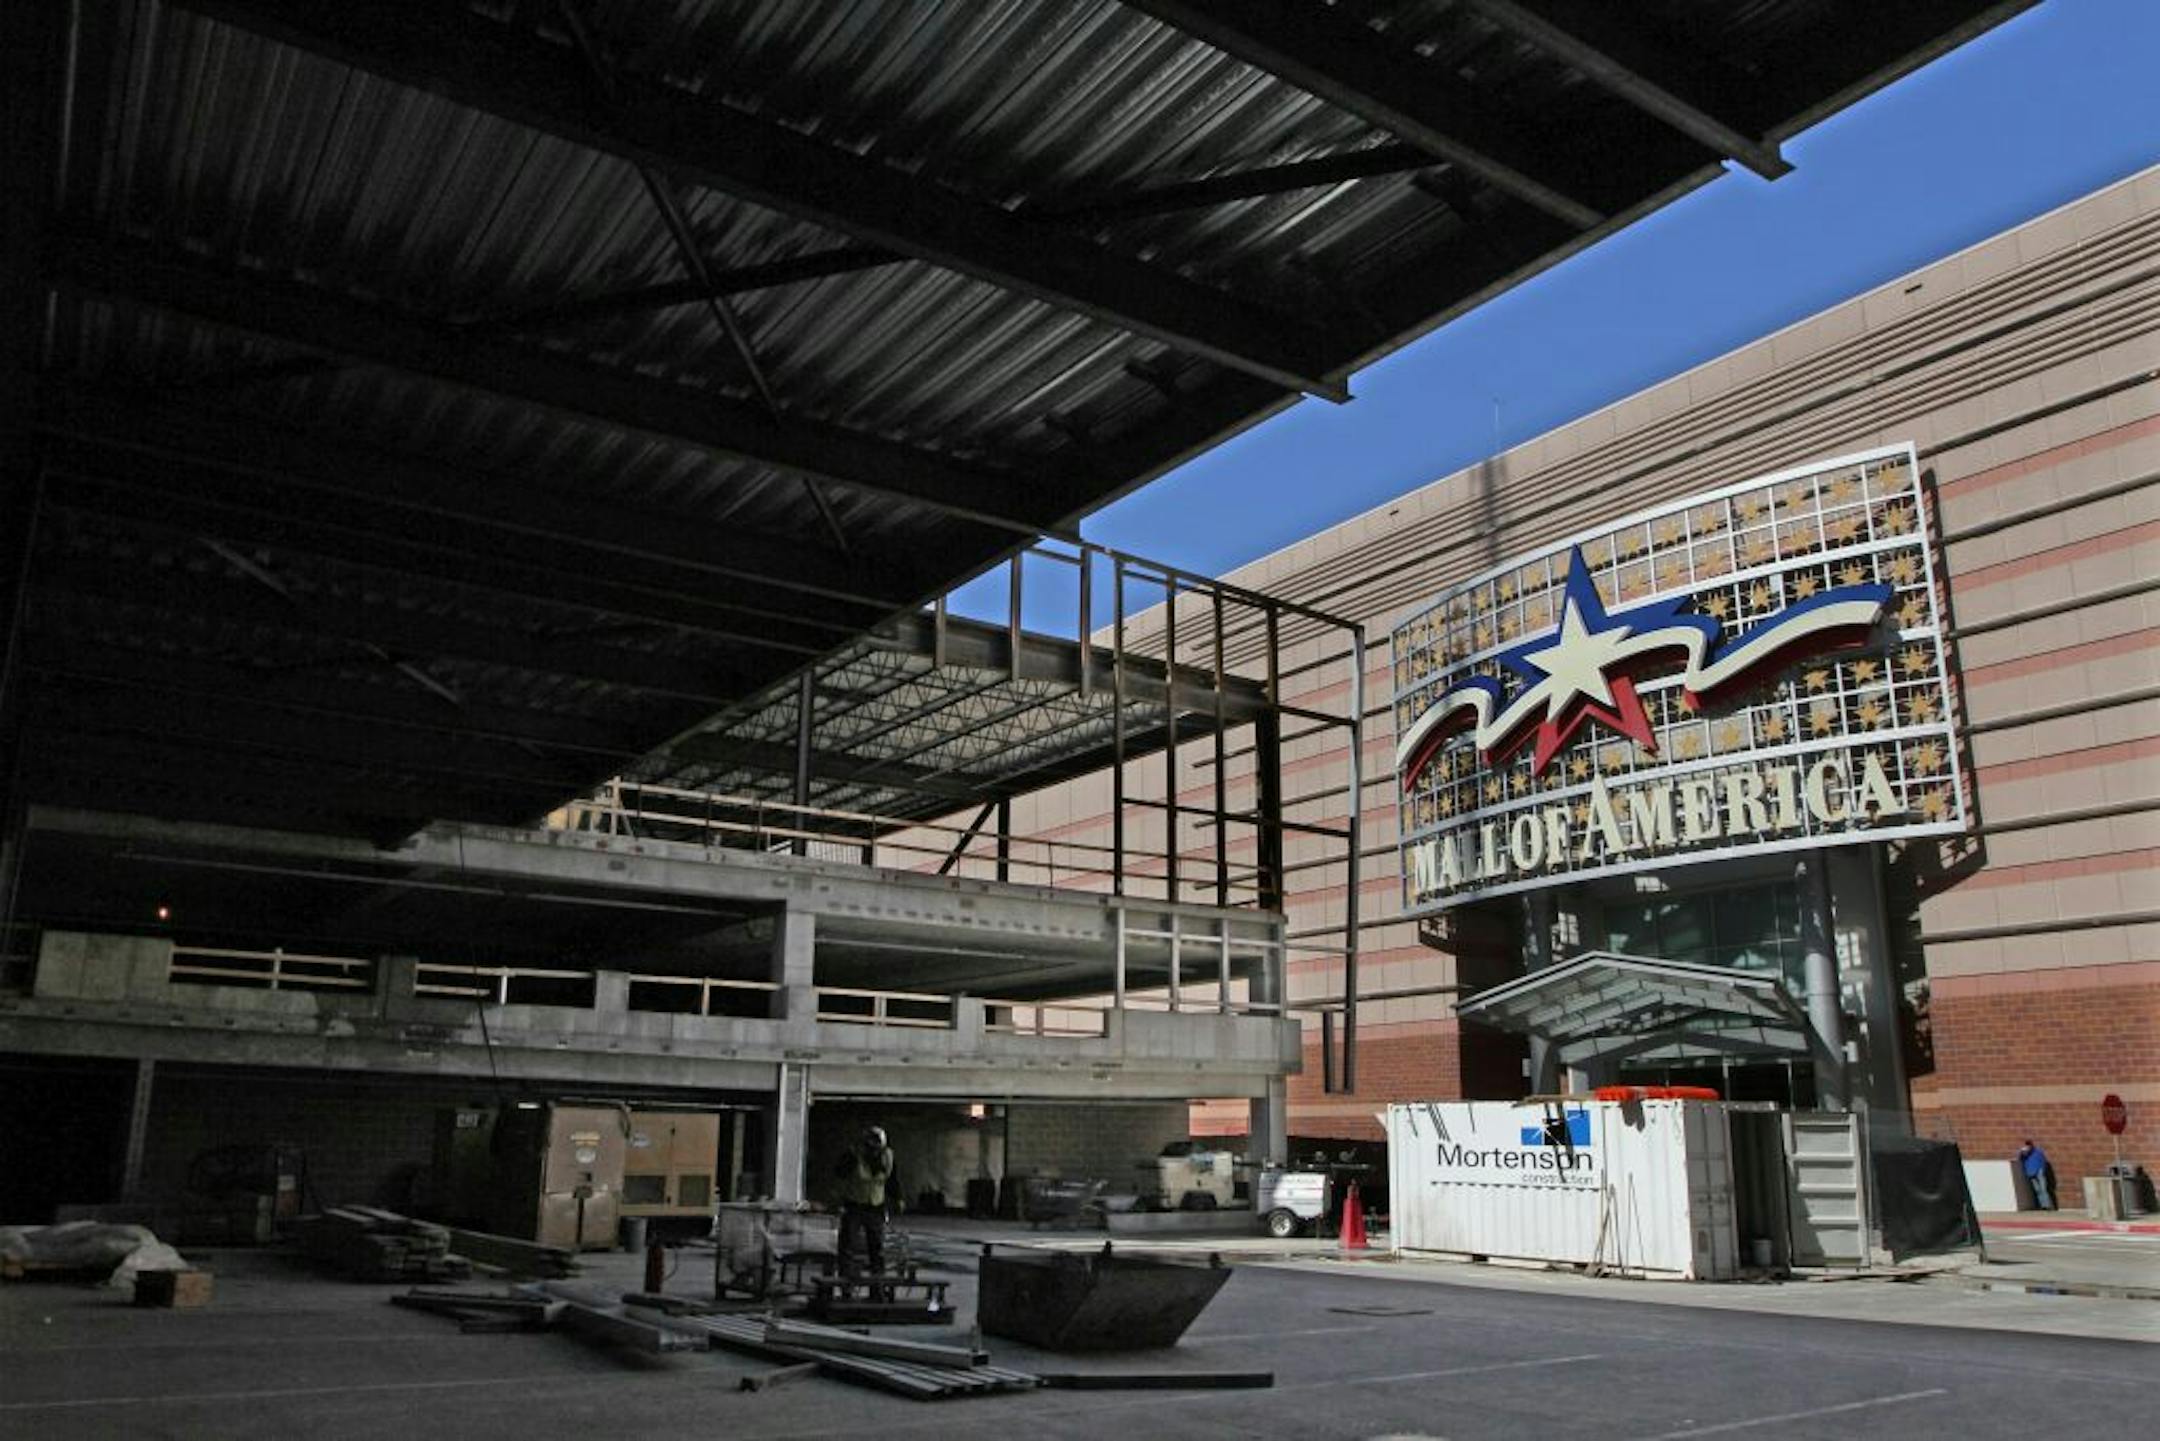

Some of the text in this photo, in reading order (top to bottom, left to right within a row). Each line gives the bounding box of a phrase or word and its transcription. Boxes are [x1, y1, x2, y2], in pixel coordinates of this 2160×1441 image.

[1414, 752, 1905, 896] MALL OF AMERICA
[1437, 1143, 1593, 1171] Mortenson
